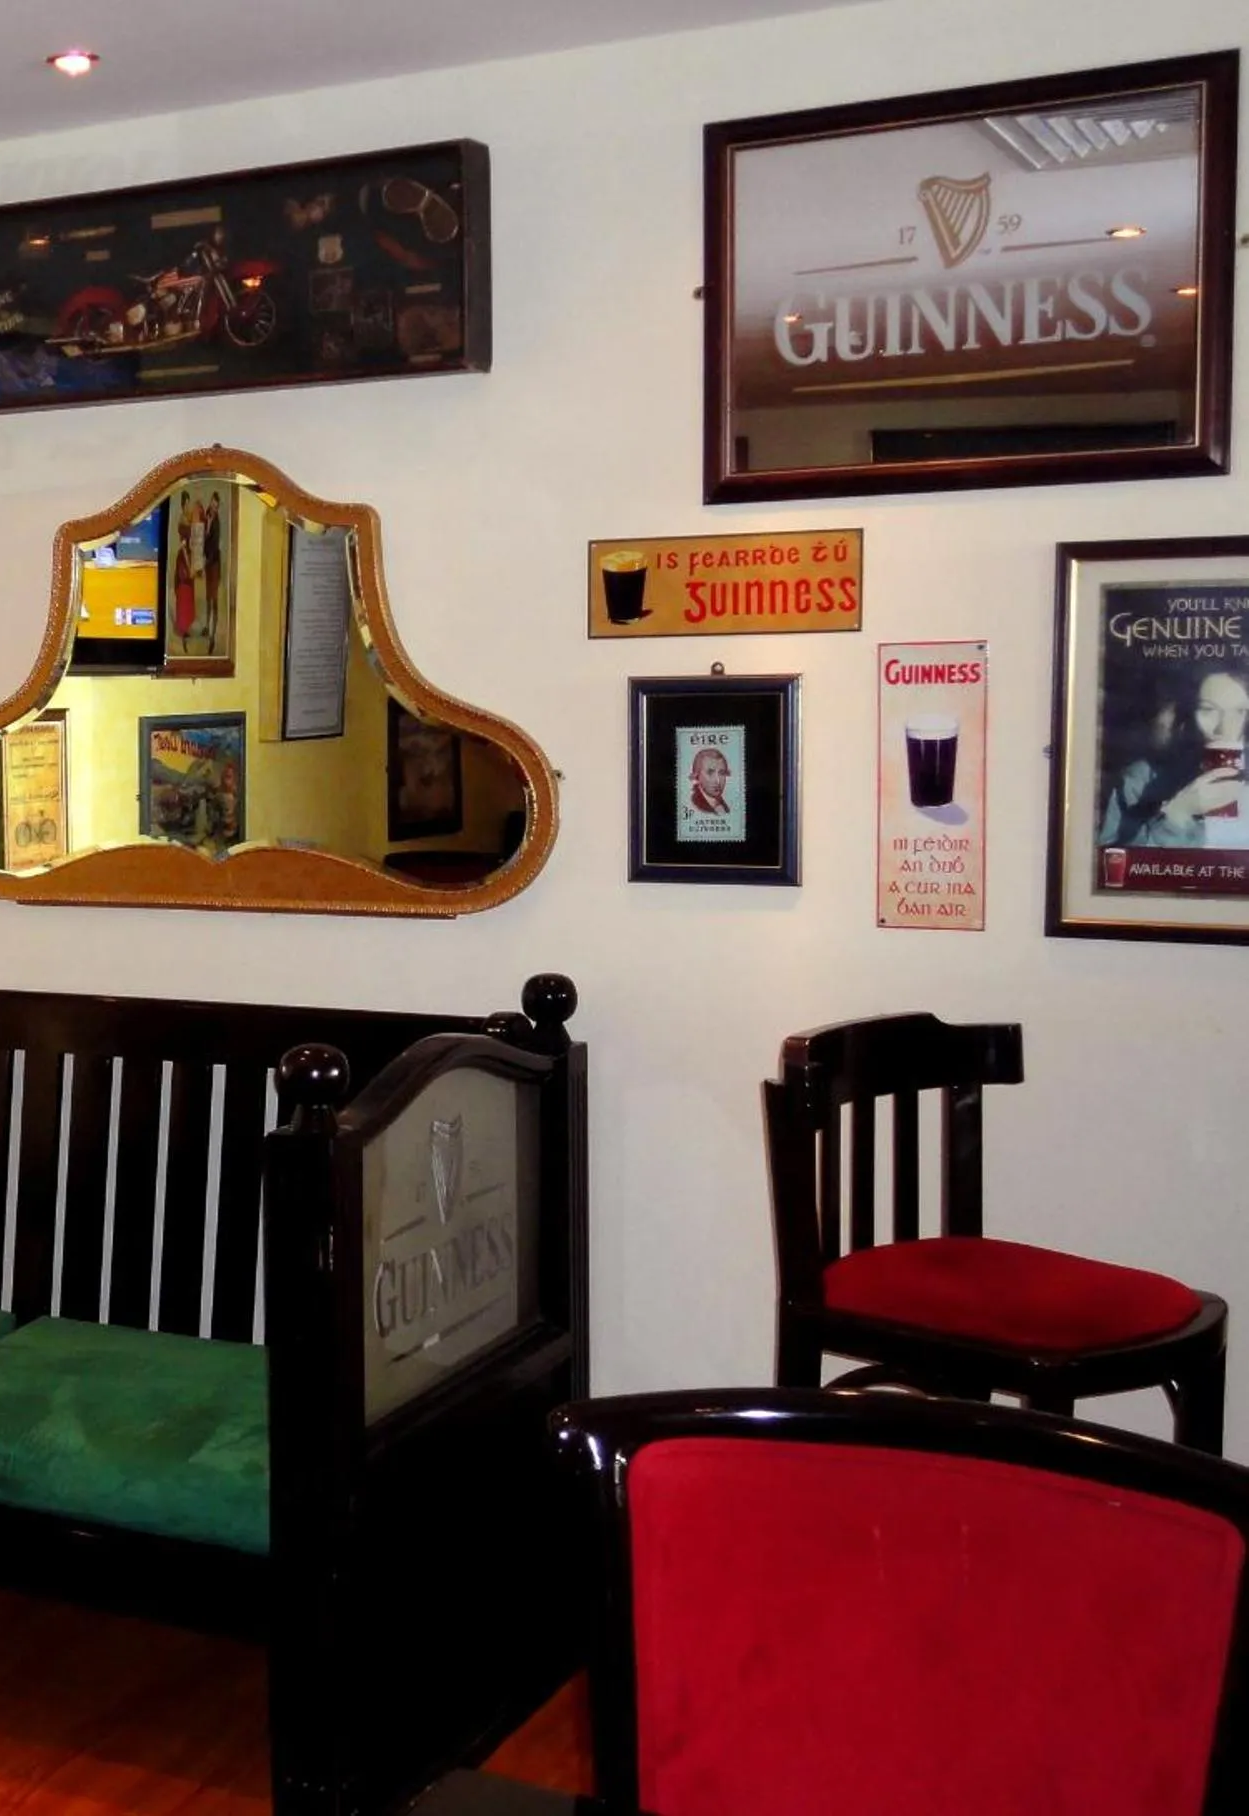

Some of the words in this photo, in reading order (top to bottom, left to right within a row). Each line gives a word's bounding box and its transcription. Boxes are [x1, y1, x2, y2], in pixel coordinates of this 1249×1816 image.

[773, 267, 1152, 367] GUINNESS
[656, 551, 679, 569] IS
[1167, 598, 1221, 614] YOU'LL
[1223, 598, 1249, 613] KN
[1110, 612, 1243, 648] GENUINE
[1142, 644, 1189, 659] WHEN
[1193, 643, 1226, 660] YOU
[885, 659, 981, 685] GUINNESS
[1129, 863, 1195, 878] AVAILABLE
[1198, 865, 1215, 878] AT
[1217, 866, 1247, 879] THE
[373, 1213, 514, 1339] GUINNESS
